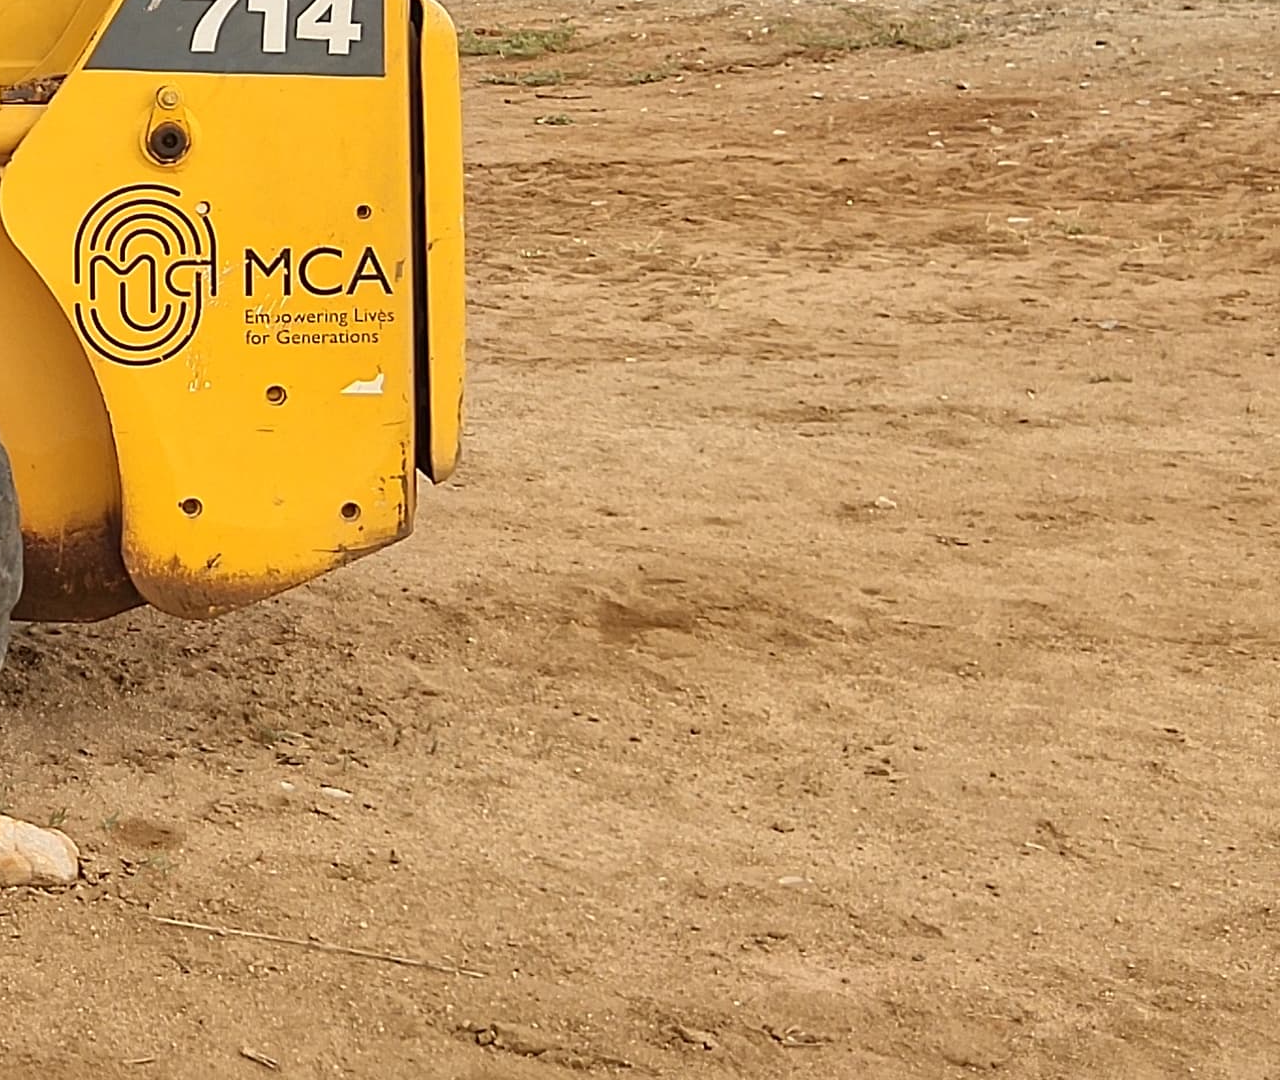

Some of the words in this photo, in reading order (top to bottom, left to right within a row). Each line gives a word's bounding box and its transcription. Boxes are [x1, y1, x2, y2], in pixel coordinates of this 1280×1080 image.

[244, 246, 394, 297] MCA
[353, 307, 396, 323] Lives
[245, 329, 271, 345] for
[276, 329, 380, 345] Generations
